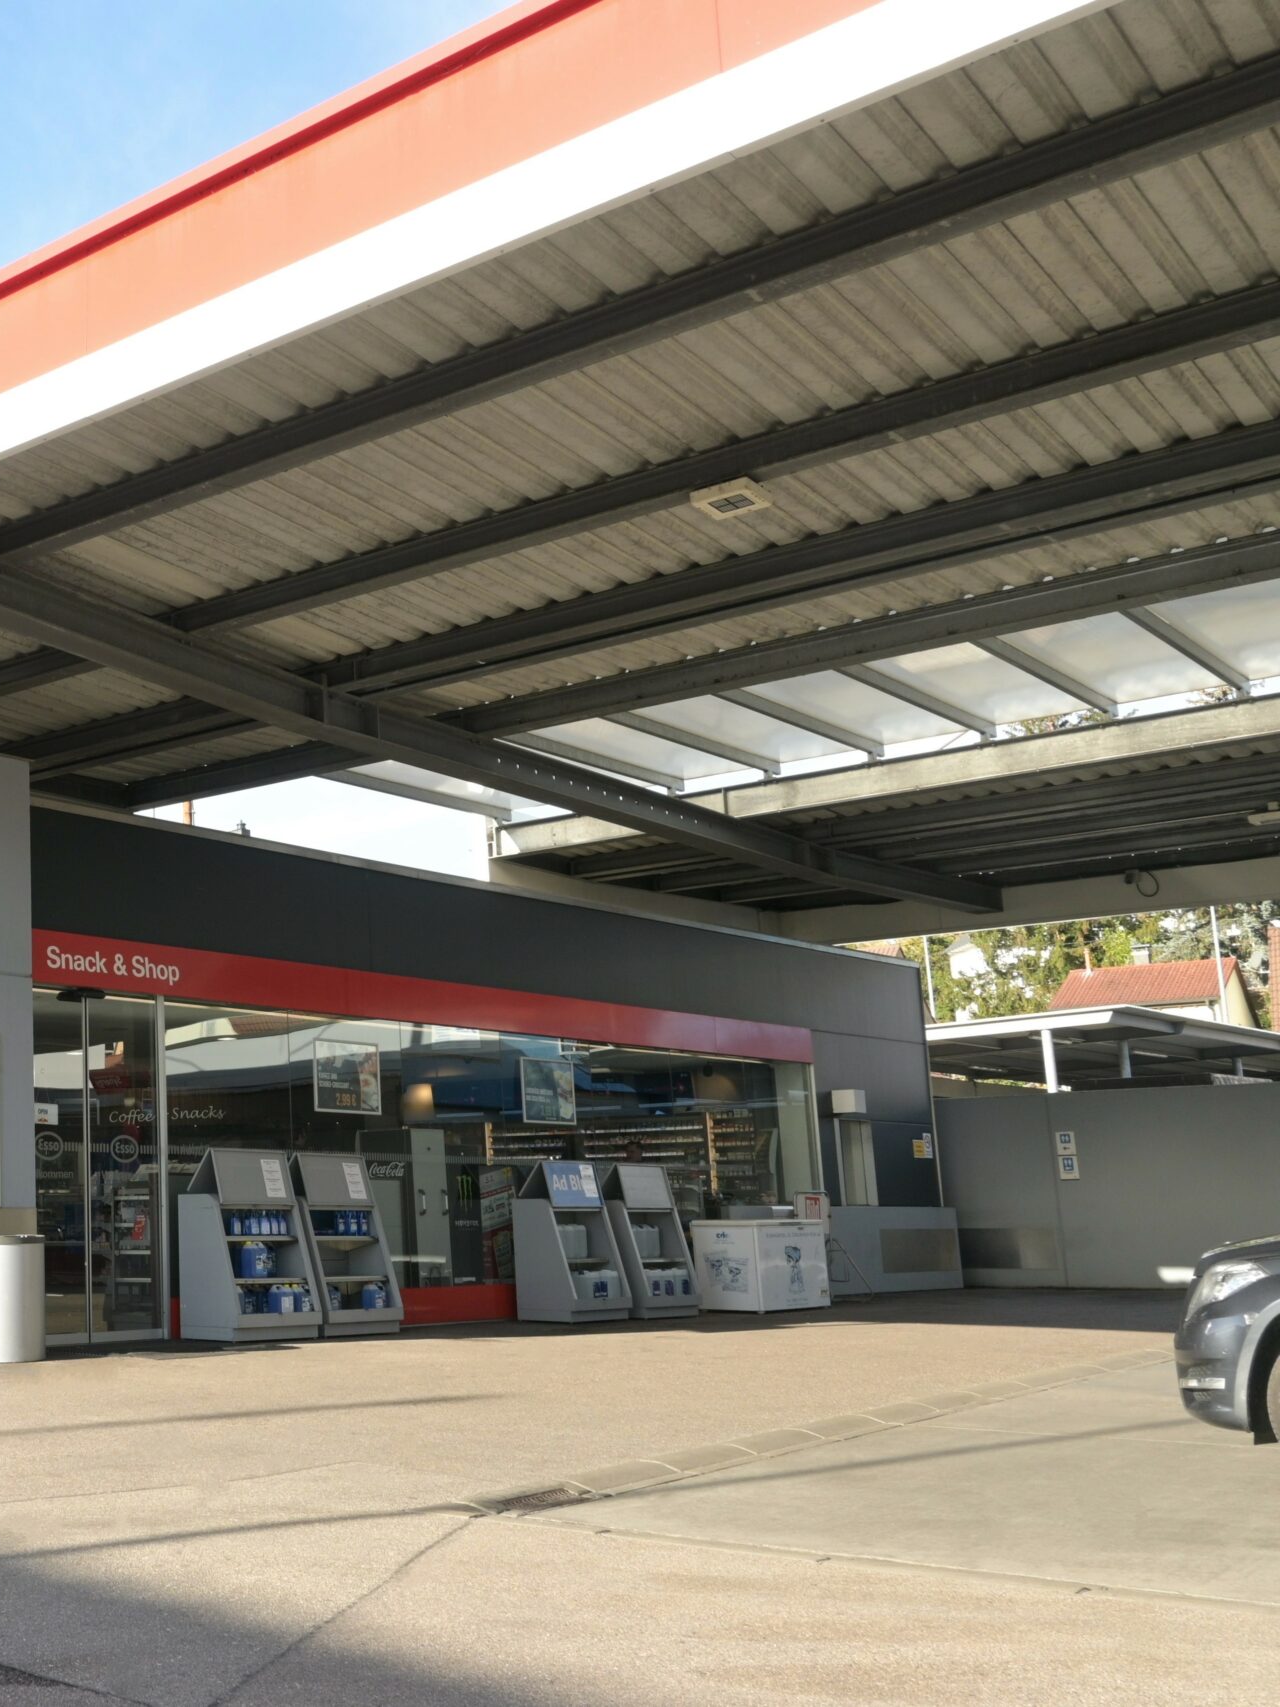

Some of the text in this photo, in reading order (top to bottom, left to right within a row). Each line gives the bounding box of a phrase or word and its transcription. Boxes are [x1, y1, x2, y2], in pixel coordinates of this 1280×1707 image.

[46, 945, 180, 986] Snack & Shop
[109, 1105, 226, 1125] Coffee Snacks
[38, 1139, 59, 1152] Esso
[114, 1142, 135, 1154] Esso
[552, 1174, 568, 1191] Ad
